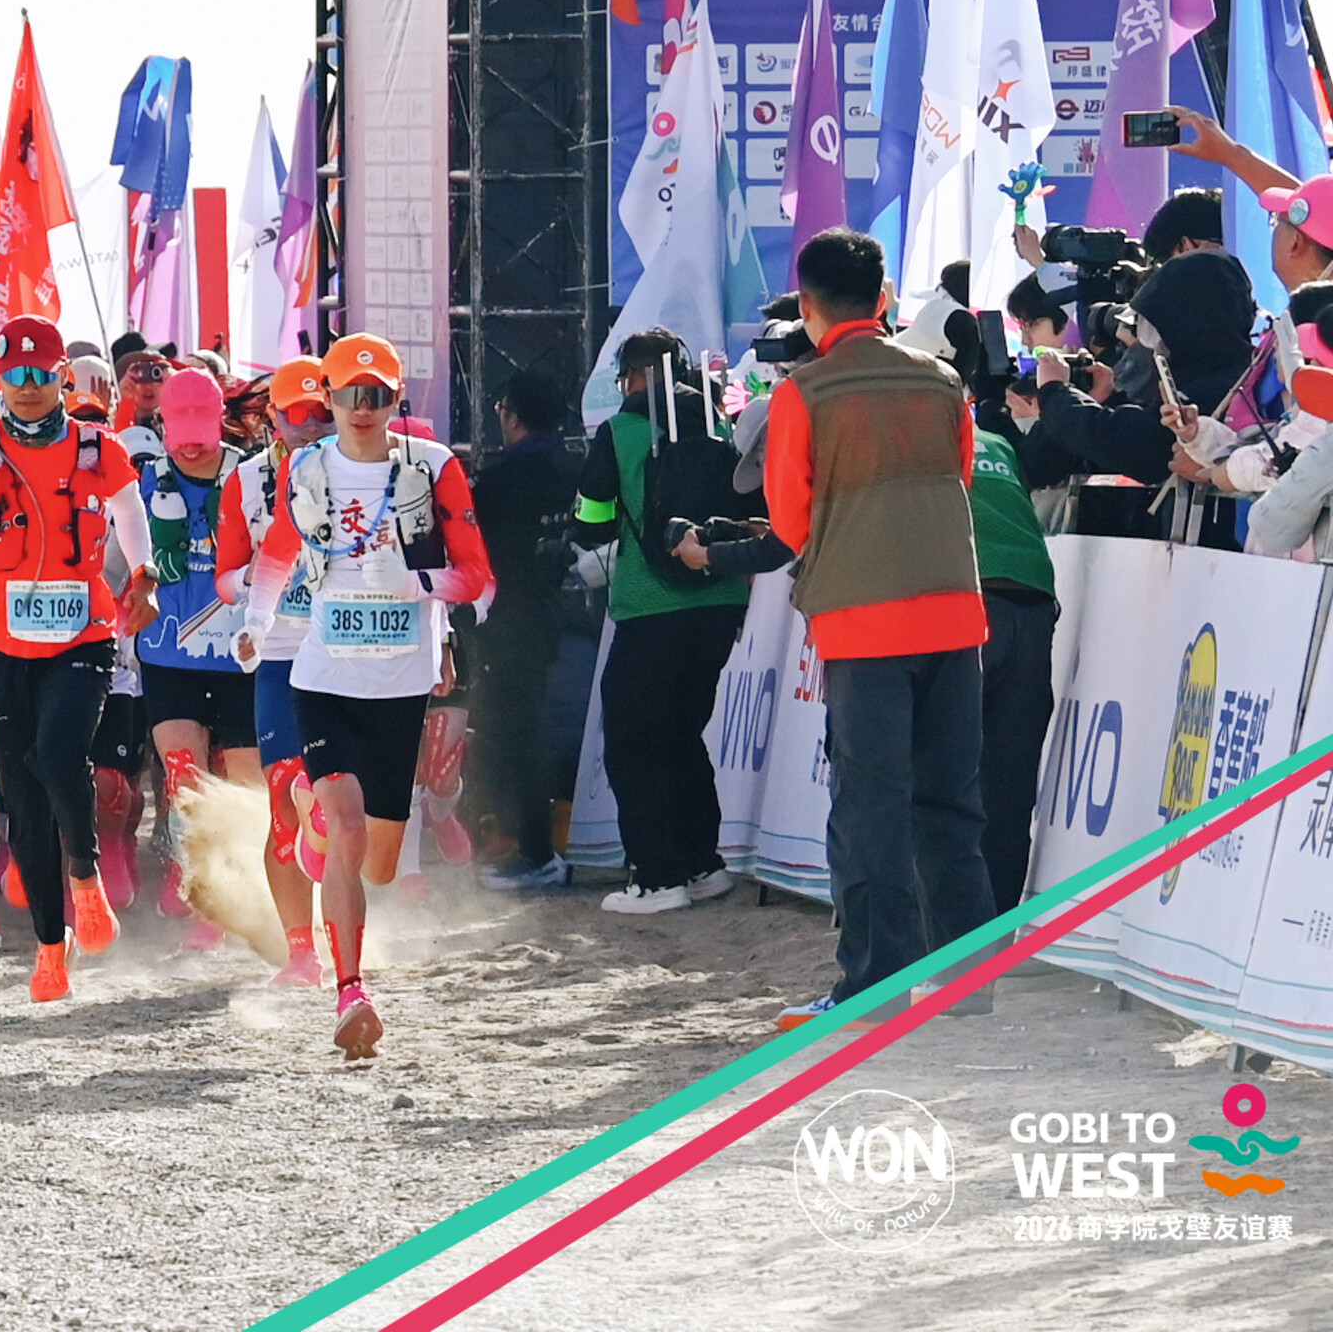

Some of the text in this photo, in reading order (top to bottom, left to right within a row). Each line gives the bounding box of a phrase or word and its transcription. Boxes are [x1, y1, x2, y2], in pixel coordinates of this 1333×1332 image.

[832, 14, 885, 33] 友情合
[49, 599, 84, 618] 1069
[331, 609, 410, 631] 38S 1032
[198, 630, 223, 638] vivo
[719, 631, 776, 773] vivo
